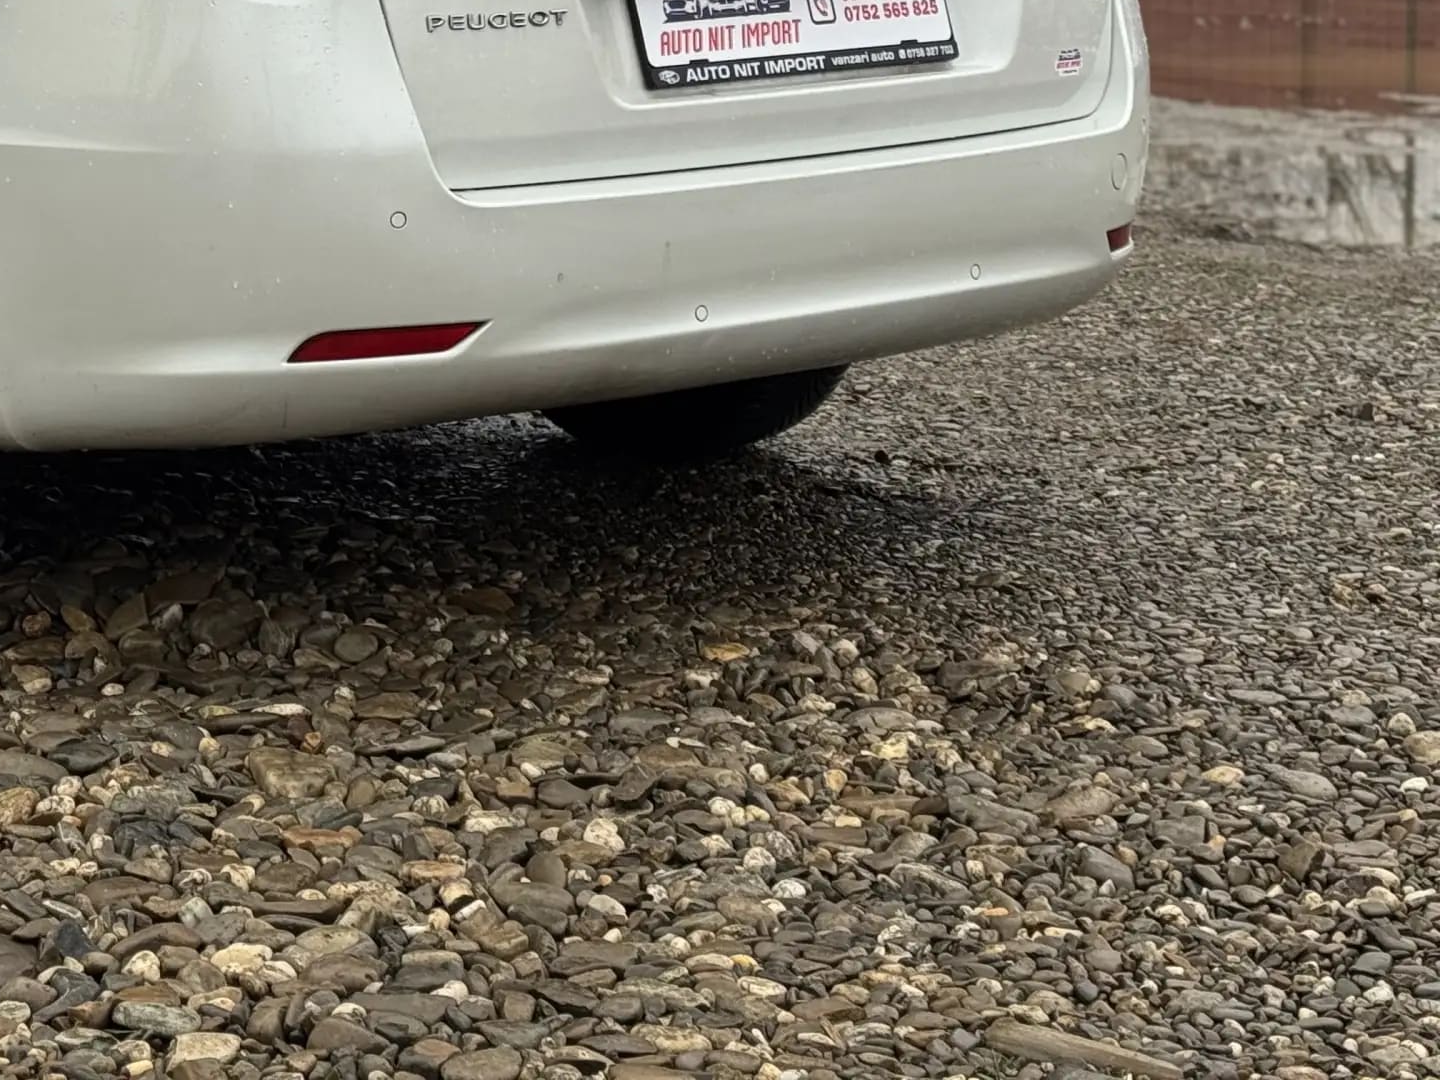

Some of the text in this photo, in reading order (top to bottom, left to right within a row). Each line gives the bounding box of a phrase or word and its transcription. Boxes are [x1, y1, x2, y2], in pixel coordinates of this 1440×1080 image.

[426, 9, 568, 33] PEUGEOT
[844, 0, 939, 22] 0752 565 825
[660, 19, 802, 56] AUTO NIT IMPORT
[686, 65, 731, 83] AUTO
[735, 61, 761, 78] NIT
[765, 55, 826, 75] IMPORT
[831, 51, 870, 66] vanzari
[871, 50, 895, 62] auto
